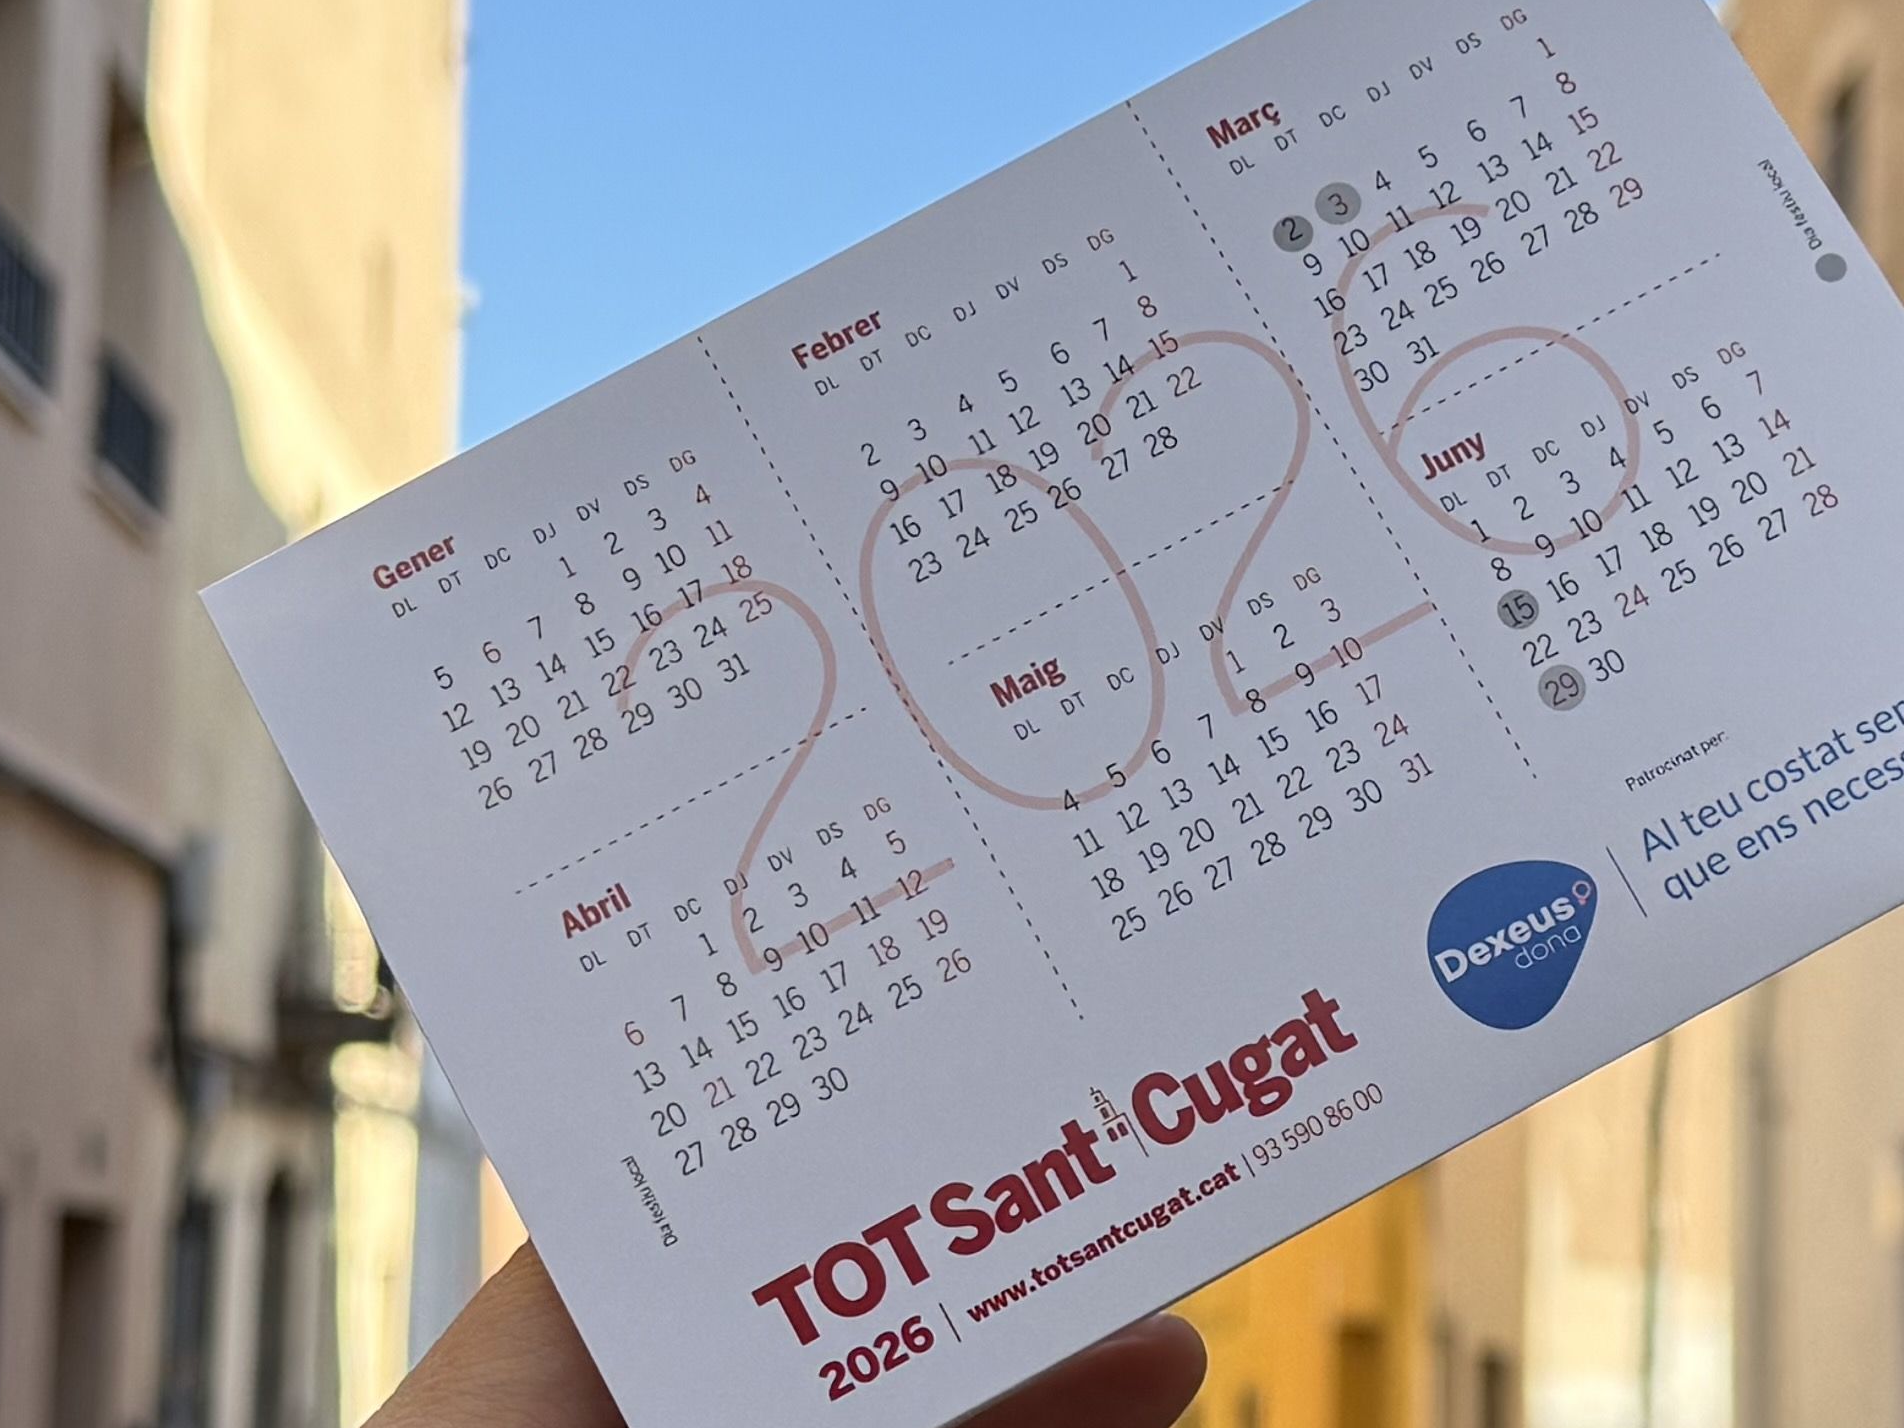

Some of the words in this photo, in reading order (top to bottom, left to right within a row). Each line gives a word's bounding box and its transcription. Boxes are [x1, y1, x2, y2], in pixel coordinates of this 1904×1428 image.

[1206, 101, 1281, 149] Març
[1229, 155, 1256, 176] DL
[1273, 128, 1298, 152] DT
[1318, 105, 1346, 128] DC
[1366, 80, 1391, 103] DJ
[1409, 56, 1433, 80] DV
[1499, 8, 1527, 31] DG
[1281, 217, 1304, 241] 2
[1328, 193, 1348, 216] 3
[1376, 170, 1391, 191] 4
[1417, 144, 1438, 168] 5
[1466, 119, 1486, 142] 6
[1509, 95, 1526, 119] 7
[1555, 71, 1576, 95] 8
[791, 310, 883, 370] Febrer
[814, 376, 840, 396] DL
[859, 348, 882, 372] DT
[904, 325, 932, 348] DC
[953, 301, 976, 322] DJ
[995, 276, 1019, 300] DV
[1041, 253, 1068, 275] DS
[1086, 228, 1115, 251] DG
[860, 442, 882, 467] 2
[907, 418, 927, 441] 3
[959, 393, 974, 413] 4
[997, 369, 1018, 393] 5
[1050, 341, 1070, 364] 6
[1092, 317, 1108, 342] 7
[1137, 295, 1157, 318] 8
[1353, 360, 1389, 392] 30
[1406, 335, 1440, 364] 31
[908, 551, 943, 584] 23
[955, 526, 990, 559] 24
[1004, 500, 1038, 533] 25
[1046, 477, 1082, 510] 26
[1100, 447, 1128, 481] 27
[1143, 426, 1178, 459] 28
[1421, 432, 1485, 480] Juny
[1439, 491, 1468, 513] DL
[1485, 463, 1511, 488] DT
[1531, 440, 1560, 464] DC
[1580, 414, 1606, 438] DJ
[1624, 391, 1650, 416] DV
[1671, 366, 1699, 389] DS
[1716, 341, 1746, 365] DG
[1490, 557, 1512, 582] 8
[1534, 534, 1555, 559] 9
[1569, 508, 1603, 540] 10
[1620, 484, 1653, 514] 11
[1665, 458, 1700, 490] 12
[1712, 433, 1745, 465] 13
[1757, 408, 1791, 440] 14
[373, 534, 455, 589] Gener
[391, 597, 418, 619] DL
[437, 570, 461, 594] DT
[483, 547, 511, 570] DC
[532, 522, 556, 544] DJ
[576, 497, 600, 521] DV
[623, 474, 650, 496] DS
[669, 450, 696, 473] DG
[433, 665, 453, 690] 5
[482, 641, 501, 664] 6
[526, 615, 542, 640] 7
[574, 592, 595, 615] 8
[622, 567, 642, 591] 9
[654, 544, 686, 574] 10
[704, 519, 734, 547] 11
[617, 203, 1640, 975] 2026
[1522, 633, 1560, 668] 22
[1567, 610, 1603, 643] 23
[1614, 584, 1650, 618] 24
[1660, 558, 1696, 593] 25
[1708, 533, 1744, 568] 26
[1757, 507, 1787, 542] 27
[1802, 484, 1839, 518] 28
[478, 776, 512, 810] 26
[528, 749, 556, 784] 27
[573, 727, 608, 761] 28
[620, 702, 654, 735] 29
[666, 677, 703, 709] 30
[717, 653, 750, 683] 31
[990, 658, 1067, 708] Maig
[1013, 719, 1041, 740] DL
[1059, 690, 1085, 716] DT
[1106, 667, 1134, 691] DC
[1155, 641, 1180, 665] DJ
[1199, 616, 1225, 641] DV
[1246, 592, 1274, 616] DS
[1292, 567, 1322, 591] DG
[1073, 828, 1105, 858] 11
[1116, 802, 1150, 835] 12
[1160, 778, 1193, 811] 13
[1207, 753, 1241, 786] 14
[1256, 726, 1289, 759] 15
[1305, 700, 1338, 734] 16
[1355, 673, 1381, 706] 17
[1112, 906, 1147, 942] 25
[1157, 880, 1193, 916] 26
[1204, 855, 1233, 891] 27
[1250, 831, 1286, 866] 28
[1298, 805, 1333, 839] 29
[1346, 779, 1383, 812] 30
[1400, 752, 1434, 783] 31
[1624, 746, 1701, 792] Patrocinat
[1641, 817, 1680, 862] Al
[1679, 789, 1742, 839] teu
[1746, 728, 1855, 802] costat
[562, 883, 632, 938] Abril
[579, 950, 608, 972] DL
[626, 922, 651, 948] DT
[673, 898, 702, 922] DC
[723, 872, 748, 897] DJ
[767, 846, 793, 872] DV
[815, 821, 844, 846] DS
[862, 797, 891, 821] DG
[698, 932, 719, 957] 1
[742, 907, 764, 934] 2
[787, 882, 808, 908] 3
[841, 856, 857, 879] 4
[885, 830, 906, 855] 5
[1435, 893, 1575, 983] Dexeus
[1663, 853, 1731, 900] que
[1736, 813, 1799, 862] ens
[633, 1061, 666, 1094] 13
[680, 1036, 714, 1069] 14
[726, 1010, 759, 1044] 15
[772, 986, 806, 1020] 16
[819, 960, 847, 994] 17
[867, 935, 901, 967] 18
[916, 909, 948, 941] 19
[1514, 923, 1582, 970] dona
[752, 1204, 930, 1346] TOT
[929, 1119, 1116, 1256] Sant
[1131, 988, 1358, 1145] Cugat
[966, 1162, 1241, 1323] www.totsantcugat.cat
[1252, 1137, 1282, 1166] 93
[1281, 1115, 1324, 1150] 590
[1323, 1099, 1353, 1127] 86
[1353, 1083, 1382, 1111] 00
[818, 1315, 935, 1401] 2026
